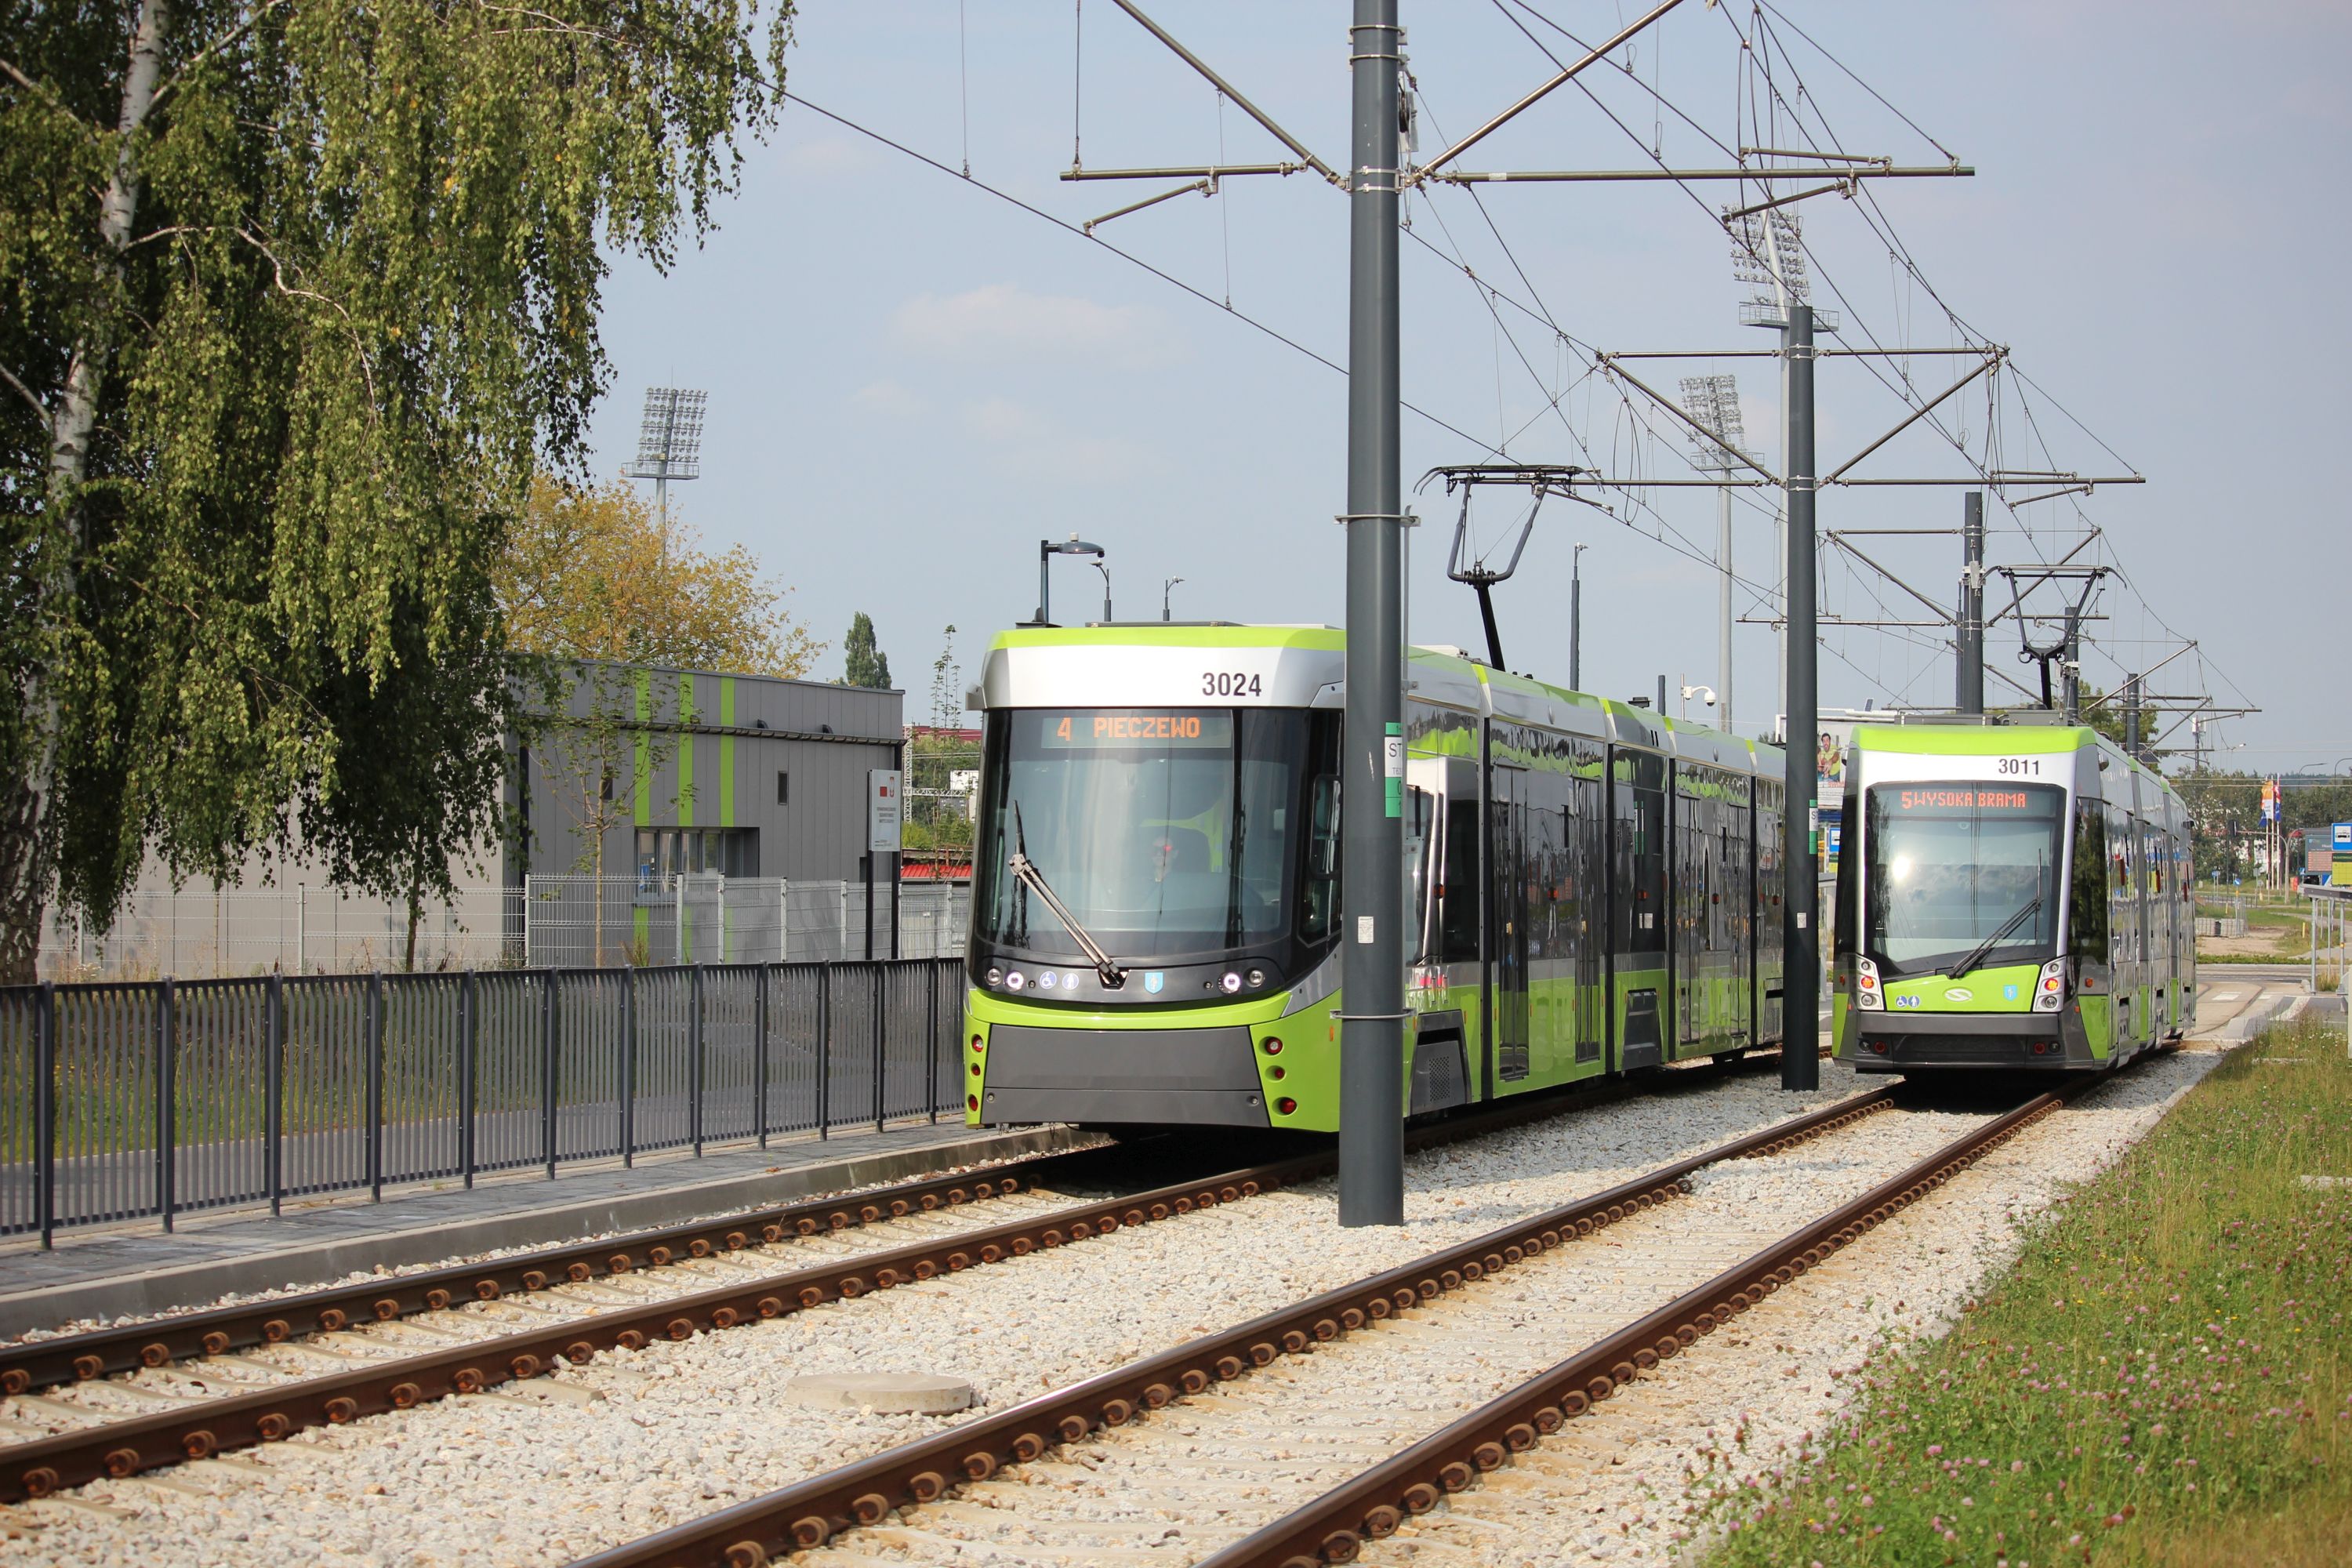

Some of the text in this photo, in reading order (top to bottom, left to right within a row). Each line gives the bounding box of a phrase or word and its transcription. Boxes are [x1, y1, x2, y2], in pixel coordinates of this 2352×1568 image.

[1202, 672, 1262, 697] 3024
[1057, 717, 1201, 742] 4 PIECZEWO
[1998, 758, 2039, 775] 3011
[1900, 790, 2027, 810] 5 WYSOKA BRAMA
